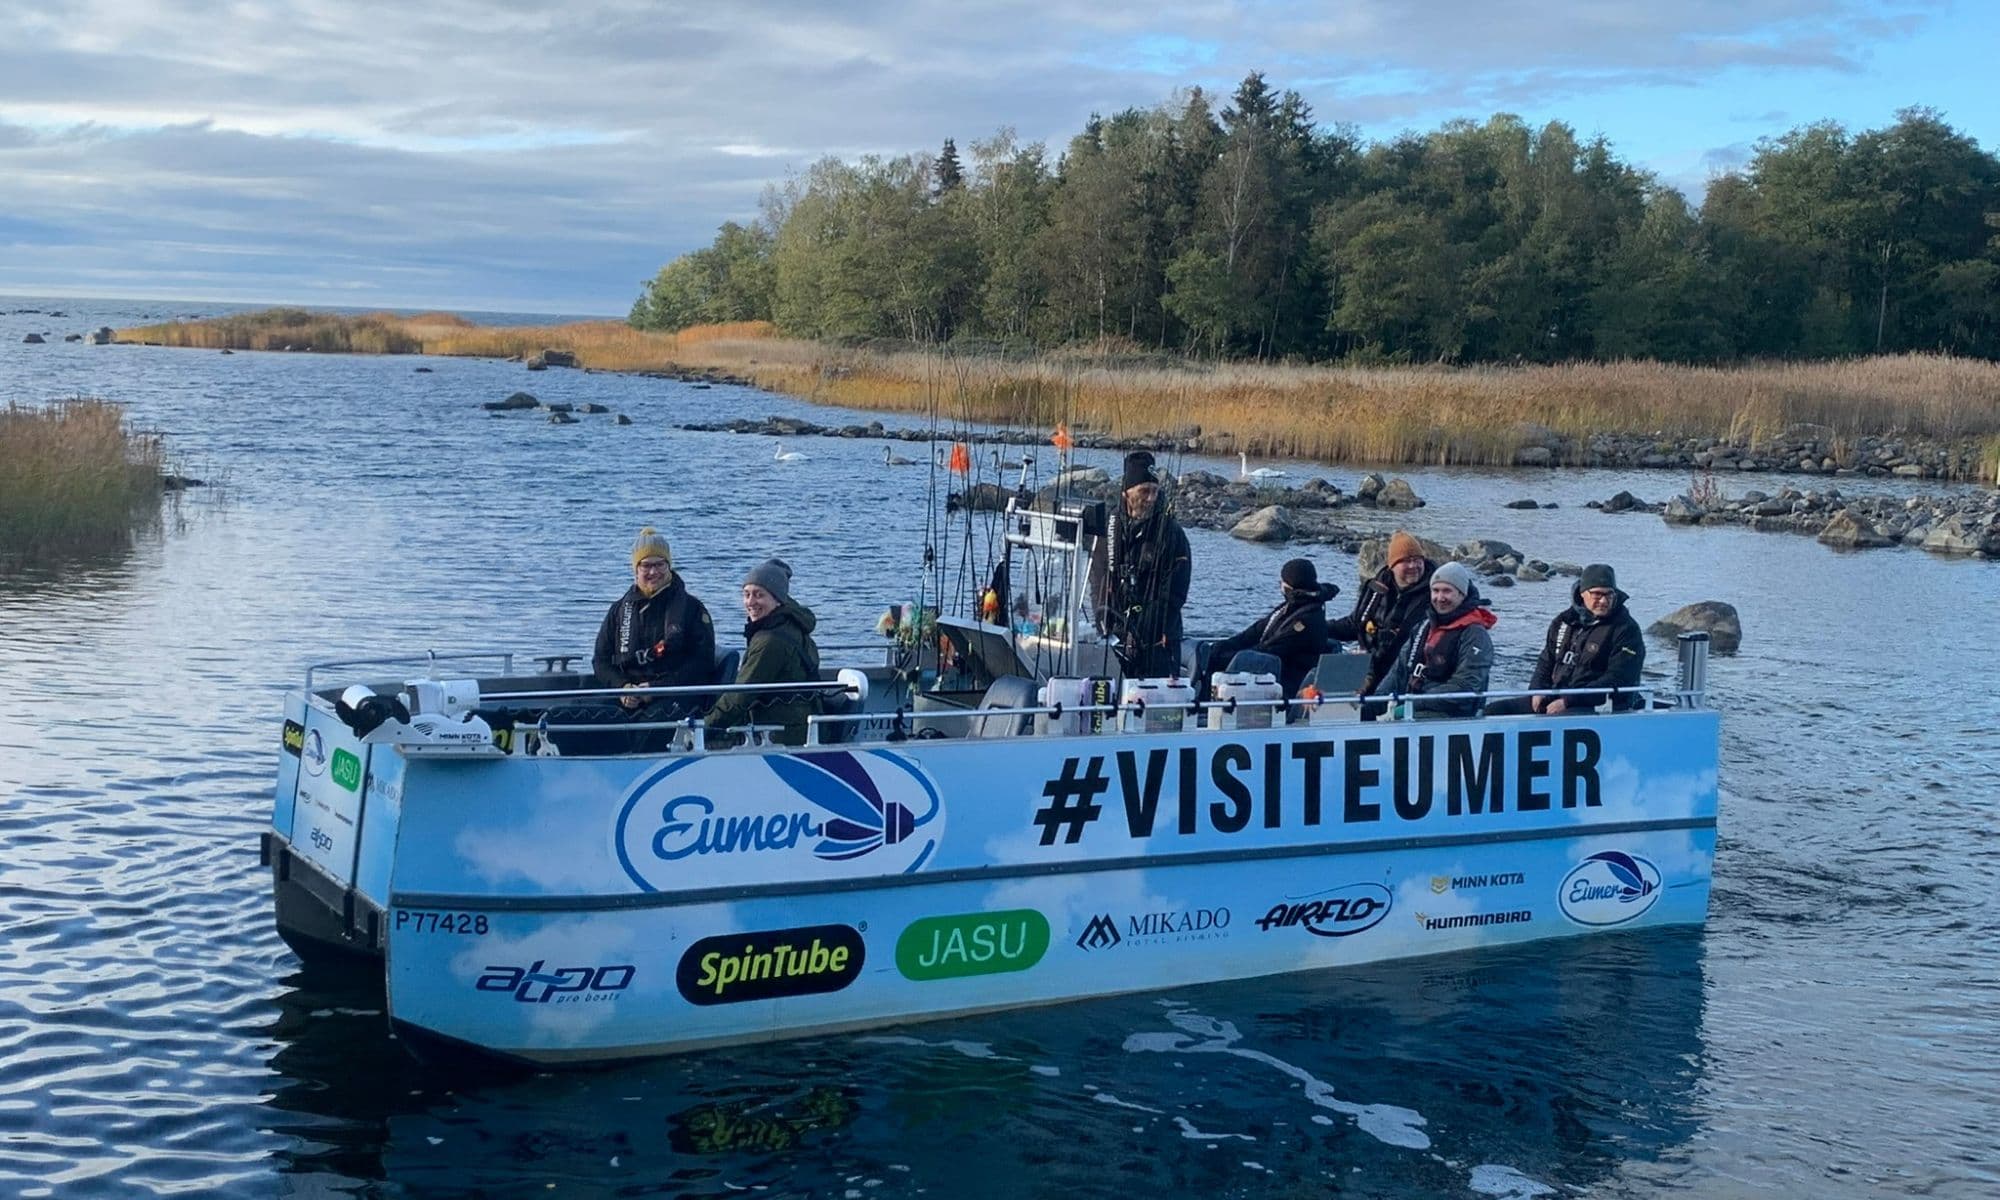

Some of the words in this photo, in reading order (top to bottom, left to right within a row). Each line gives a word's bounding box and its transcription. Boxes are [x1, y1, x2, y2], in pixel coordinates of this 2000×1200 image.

[334, 755, 358, 784] JASU
[1033, 728, 1603, 847] #VISITEUMER
[652, 795, 820, 861] Eumer
[1451, 875, 1488, 890] MINN
[1490, 872, 1525, 887] KOTA
[1569, 878, 1623, 903] Eumer
[396, 910, 489, 935] P77428
[1128, 907, 1231, 937] MIKADO
[1255, 897, 1385, 932] AIRFLO
[919, 921, 1027, 968] JASU
[697, 939, 849, 995] SpinTube
